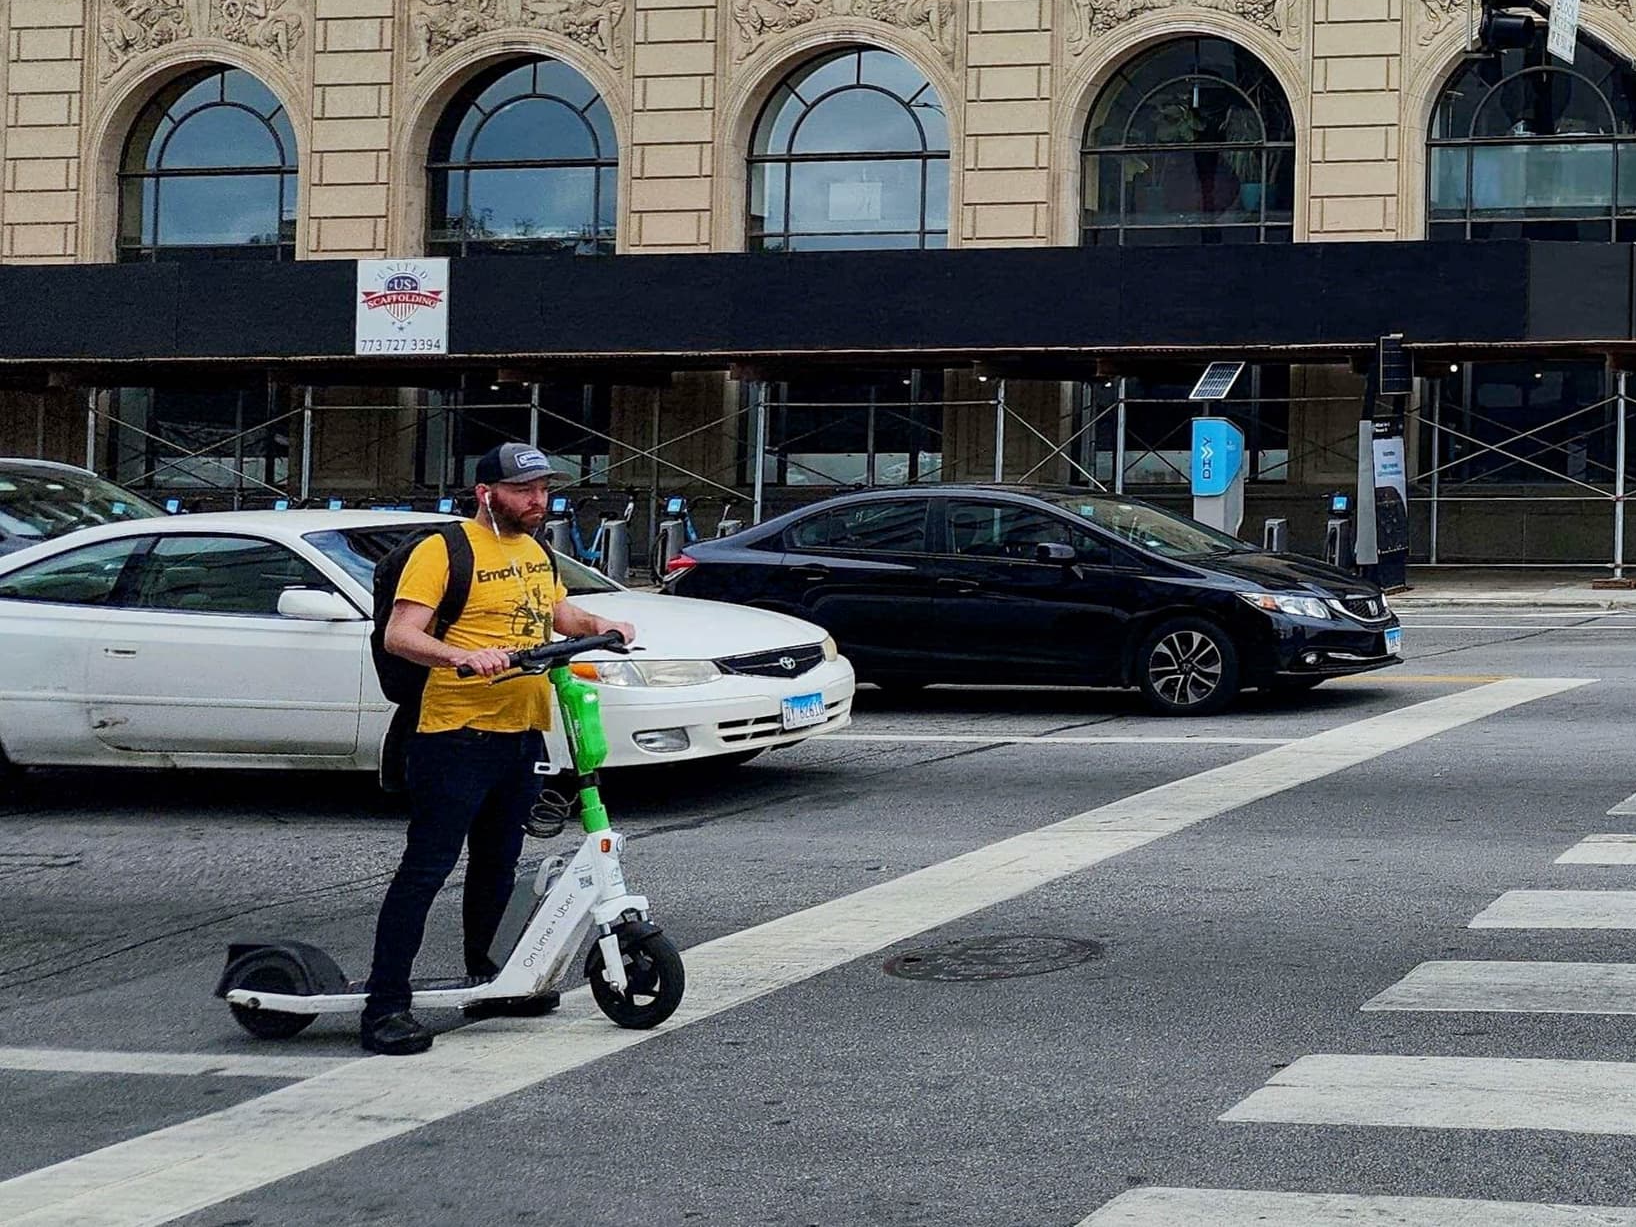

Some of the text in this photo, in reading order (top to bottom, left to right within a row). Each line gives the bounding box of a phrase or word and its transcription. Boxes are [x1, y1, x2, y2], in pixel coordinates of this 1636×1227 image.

[377, 263, 428, 280] UNITED
[394, 279, 412, 291] US
[367, 293, 437, 309] SCAFFOLDING
[361, 338, 441, 351] 773 727 3394
[476, 563, 523, 584] Empty
[523, 951, 538, 968] On
[537, 926, 554, 953] Lime
[554, 892, 577, 919] Uber
